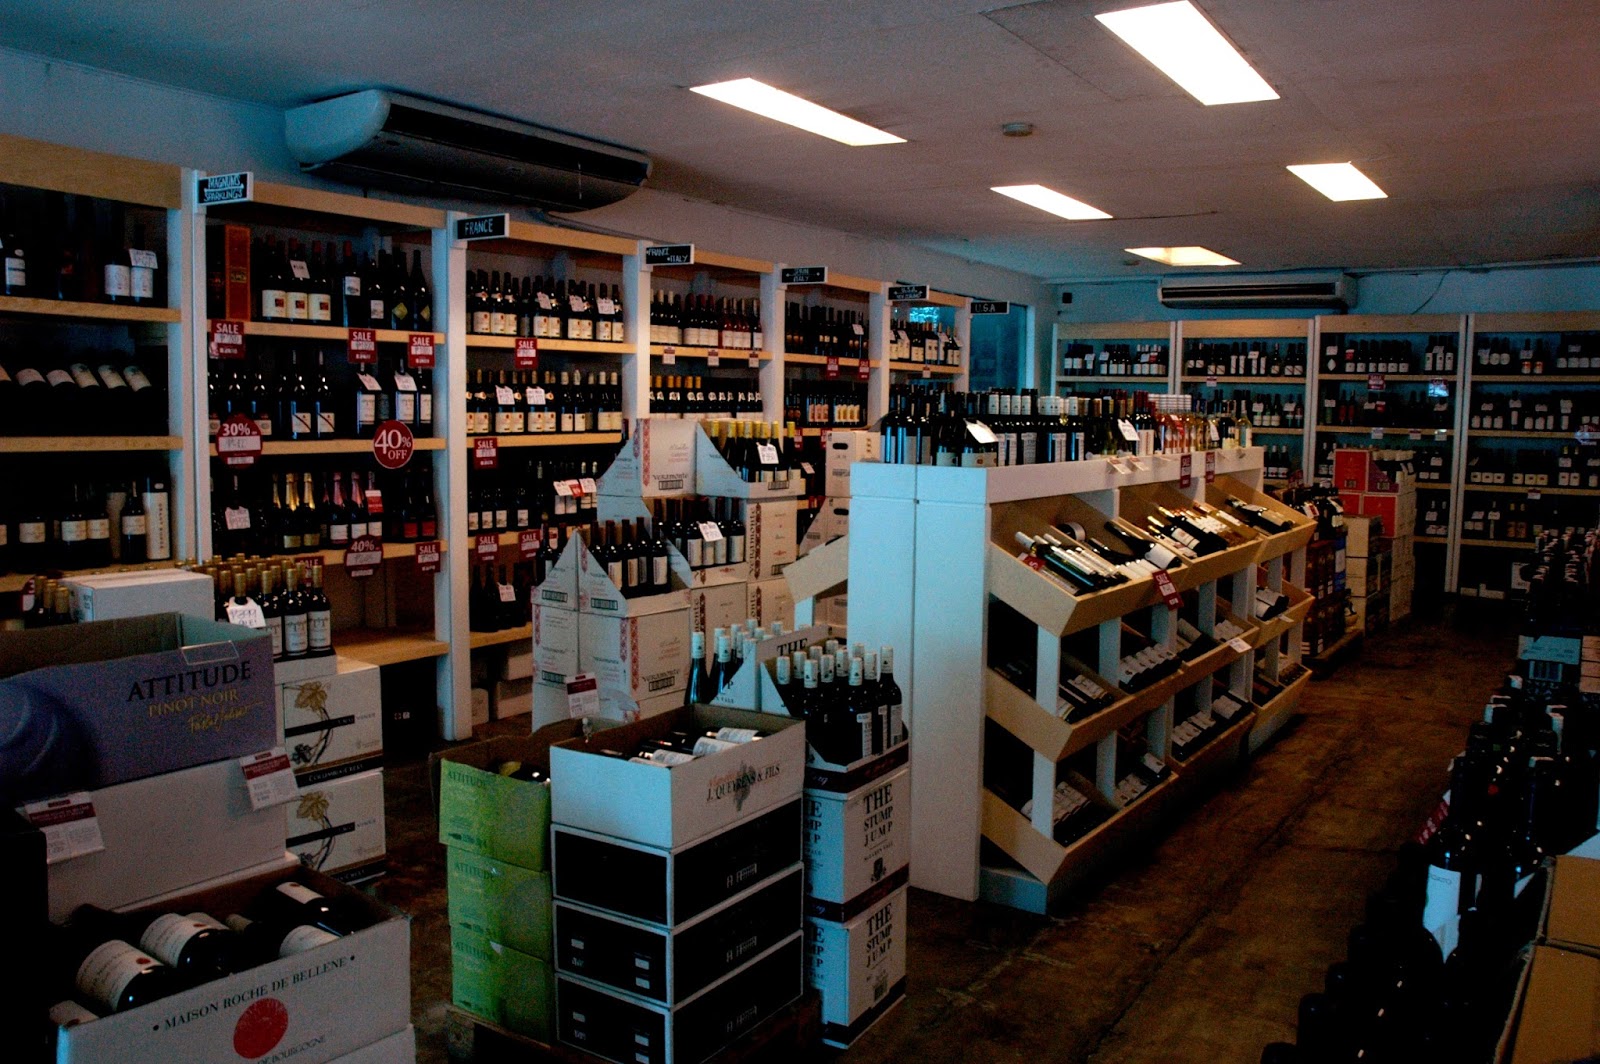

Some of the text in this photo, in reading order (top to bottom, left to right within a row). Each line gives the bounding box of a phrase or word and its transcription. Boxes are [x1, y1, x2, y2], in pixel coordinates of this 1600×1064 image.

[464, 218, 493, 236] FRANCE
[670, 254, 688, 263] ITALY
[216, 323, 239, 334] SALE
[352, 331, 371, 341] SALE
[412, 336, 430, 346] SALE
[518, 340, 534, 349] SALE
[222, 423, 250, 436] 30%
[374, 429, 412, 454] 40%
[477, 440, 493, 448] SALE
[387, 449, 408, 460] OFF
[479, 535, 495, 544] SALE
[522, 533, 537, 541] SALE
[351, 540, 375, 552] 40%
[419, 545, 436, 554] SALE
[777, 638, 808, 657] THE
[127, 661, 251, 702] ATTITUDE
[148, 688, 239, 718] PINOT NOIR
[765, 765, 780, 779] FILS
[863, 784, 894, 814] THE
[863, 806, 893, 831] STUMP
[864, 821, 893, 847] JUMP
[866, 903, 893, 936] THE
[866, 924, 893, 953] STUMP
[866, 938, 893, 968] JUMP
[164, 957, 347, 1028] MAISON ROCHE DE BELLENE
